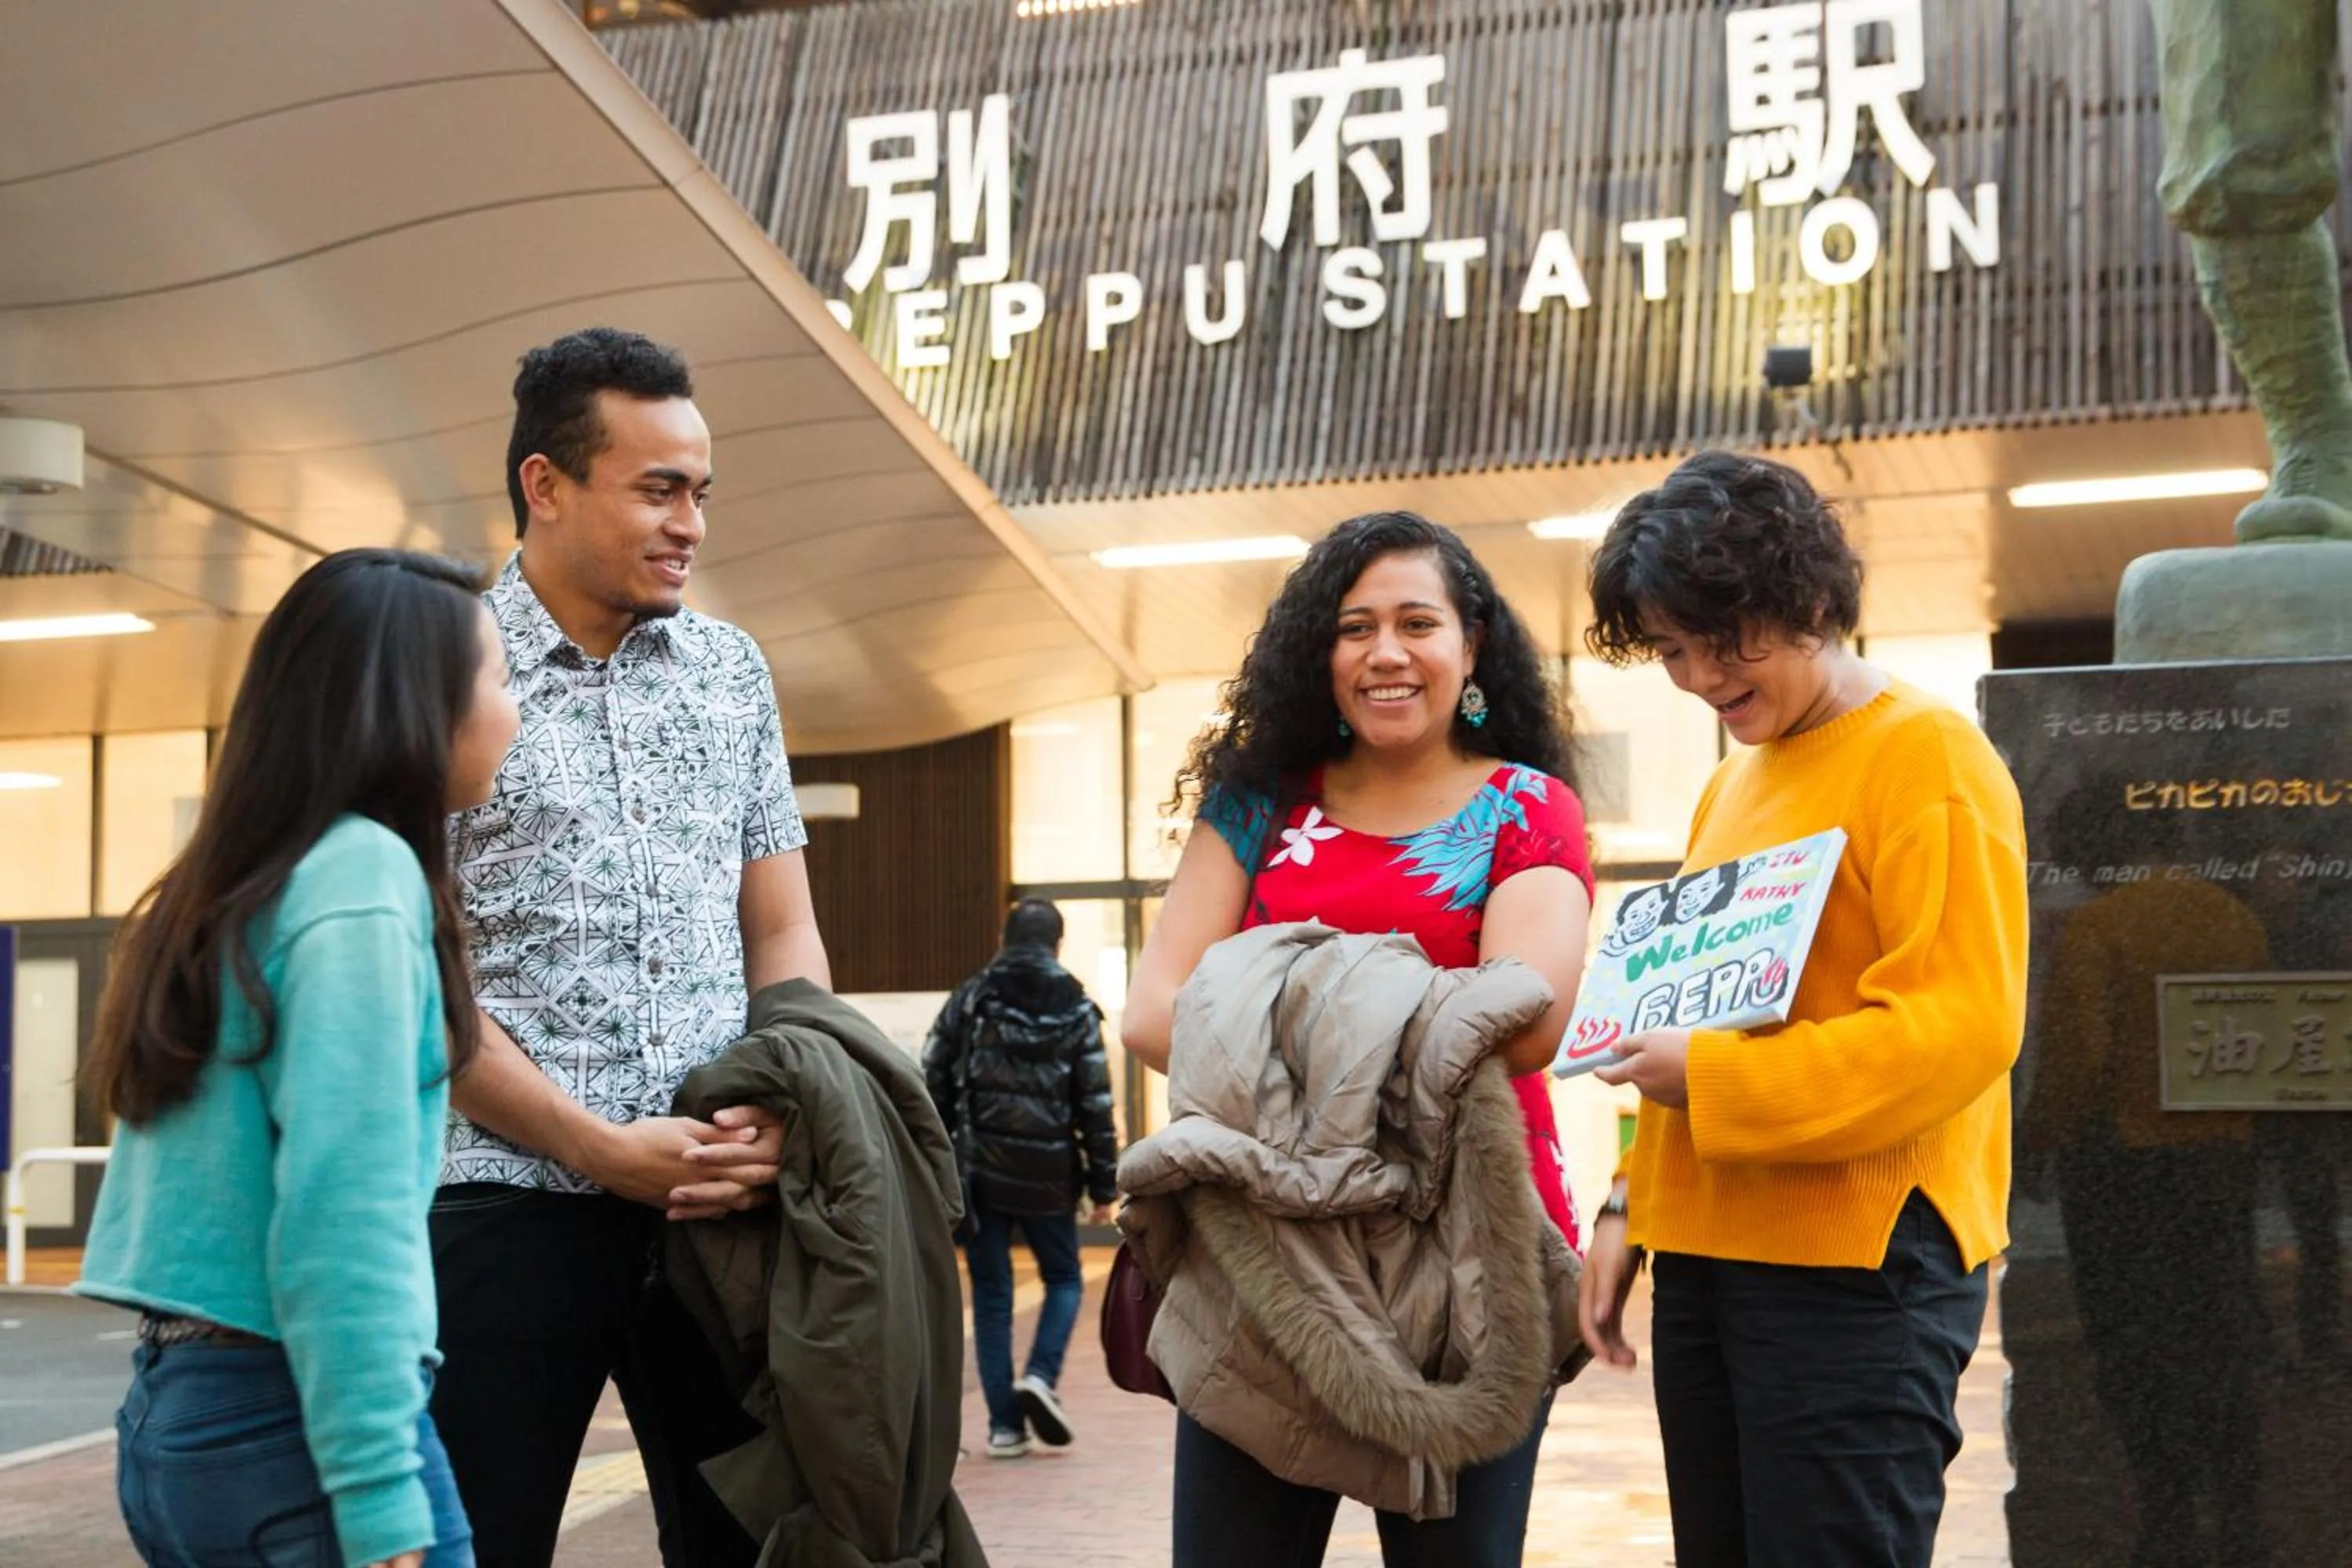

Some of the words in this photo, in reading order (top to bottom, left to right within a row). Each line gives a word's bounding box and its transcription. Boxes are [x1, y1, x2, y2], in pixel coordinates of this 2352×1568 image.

[844, 0, 1936, 294] 別府駅
[825, 260, 1246, 368] EPPU
[1322, 183, 2001, 329] STATION
[1740, 882, 1807, 901] KATHY
[2028, 862, 2078, 884] The
[2092, 865, 2151, 883] man
[2165, 855, 2261, 881] called
[1625, 902, 1795, 983] Welcome
[1630, 947, 1790, 1035] BEPPU
